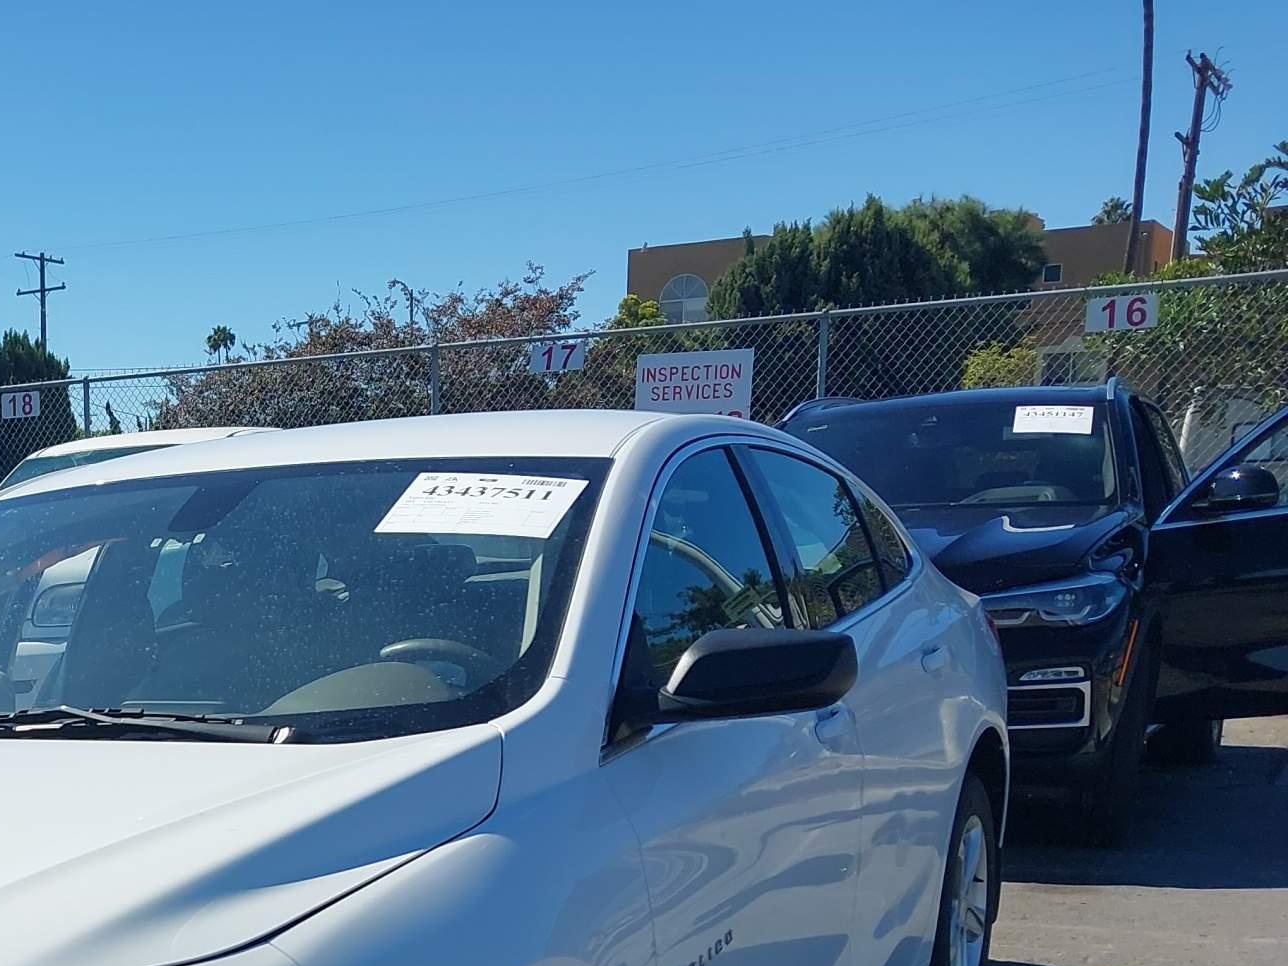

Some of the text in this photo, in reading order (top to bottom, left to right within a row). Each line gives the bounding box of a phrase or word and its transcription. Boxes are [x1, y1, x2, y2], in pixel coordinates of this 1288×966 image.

[1102, 297, 1147, 328] 16
[542, 344, 577, 370] 17
[641, 363, 742, 383] INSPECTION
[650, 383, 733, 401] SERVICES
[8, 393, 33, 416] 18
[422, 485, 554, 501] 43437511
